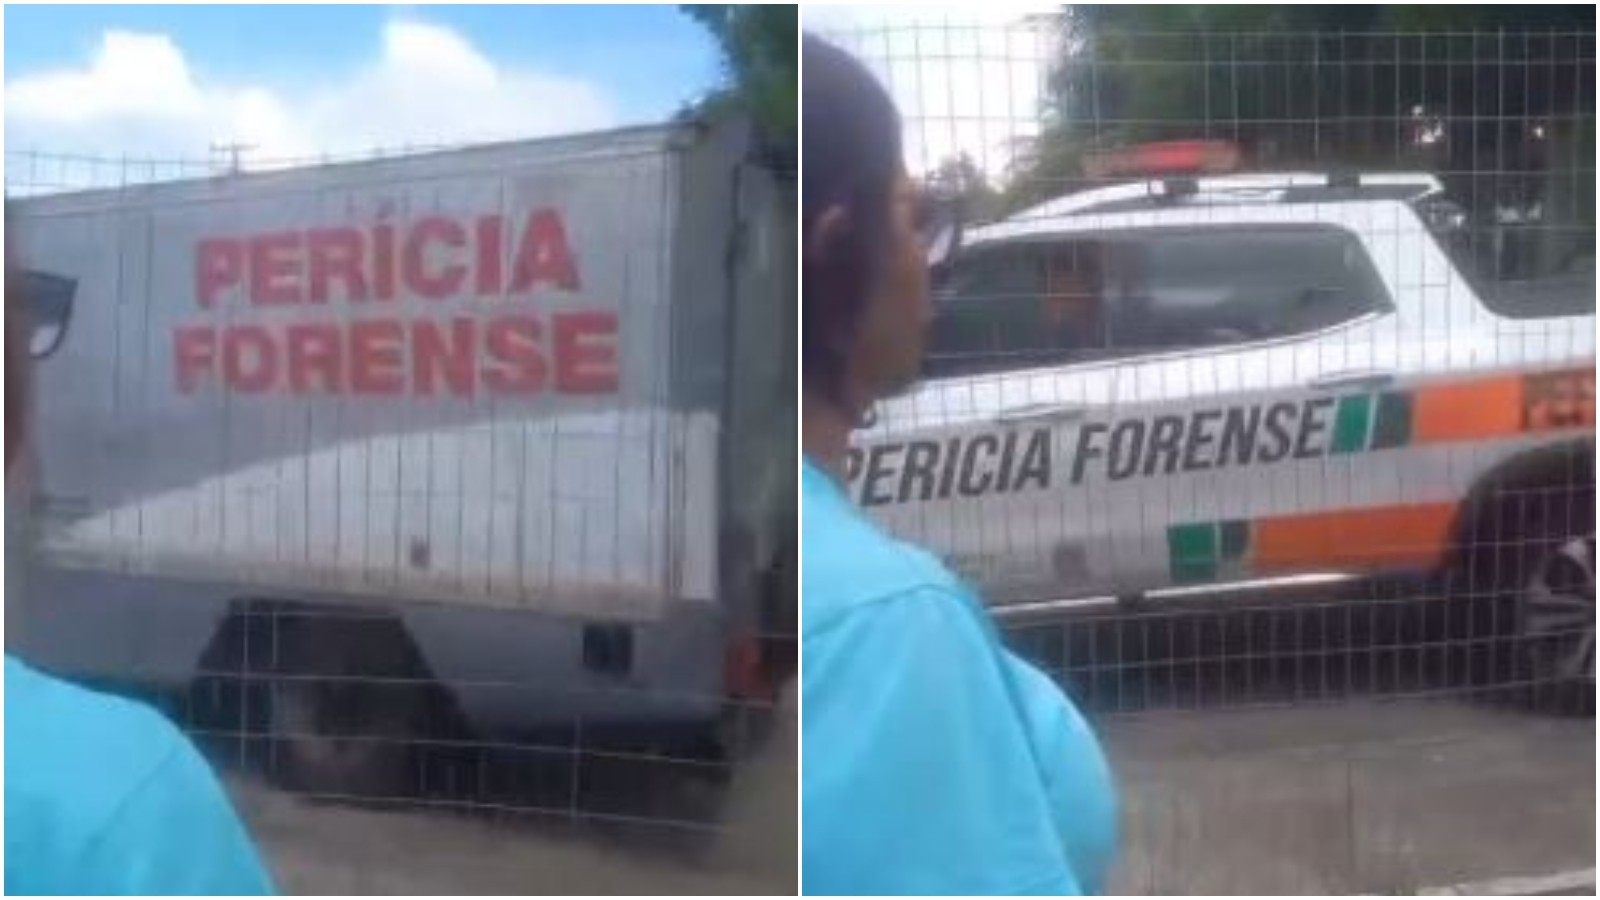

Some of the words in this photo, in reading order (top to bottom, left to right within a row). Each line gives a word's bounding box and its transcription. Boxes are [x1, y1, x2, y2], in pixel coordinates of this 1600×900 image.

[195, 203, 581, 307] PERÍCIA
[173, 312, 620, 399] FORENSE
[1070, 398, 1333, 485] FORENSE
